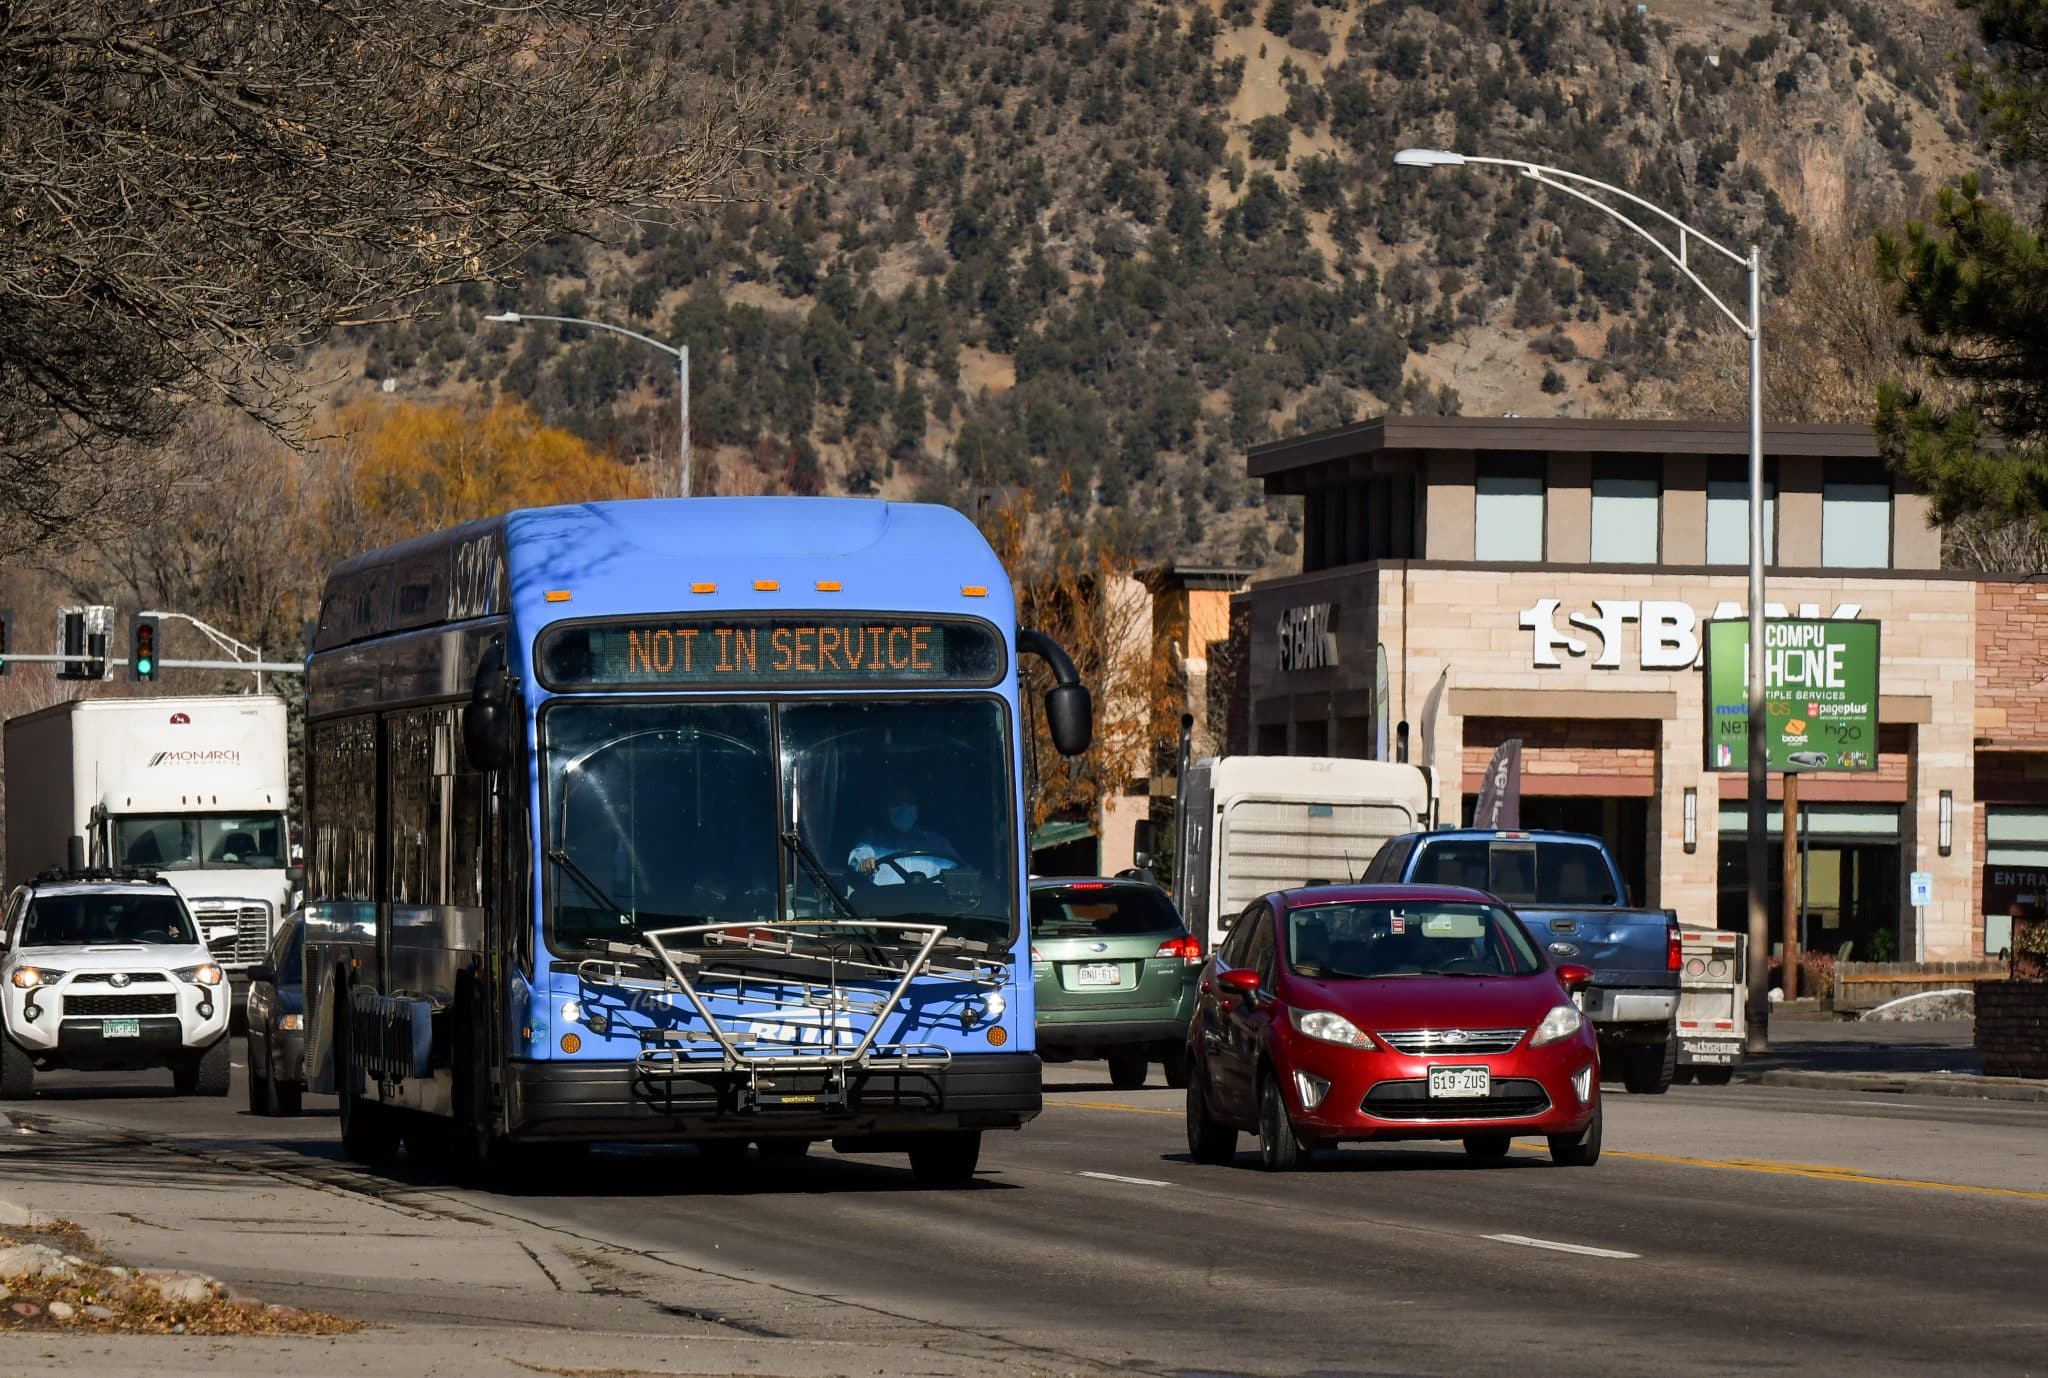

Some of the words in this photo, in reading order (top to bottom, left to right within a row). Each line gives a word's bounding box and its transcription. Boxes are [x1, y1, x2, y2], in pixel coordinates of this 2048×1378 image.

[1518, 598, 1862, 671] 1STB
[1765, 625, 1825, 648] COMPU
[628, 629, 699, 672] NOT
[715, 629, 756, 671] IN
[771, 626, 932, 670] SERVICE
[1743, 690, 1792, 700] MTIPLE
[1796, 690, 1846, 700] SERVICES
[1782, 735, 1808, 743] boost
[165, 750, 240, 761] MONARCH
[627, 990, 673, 1012] 740
